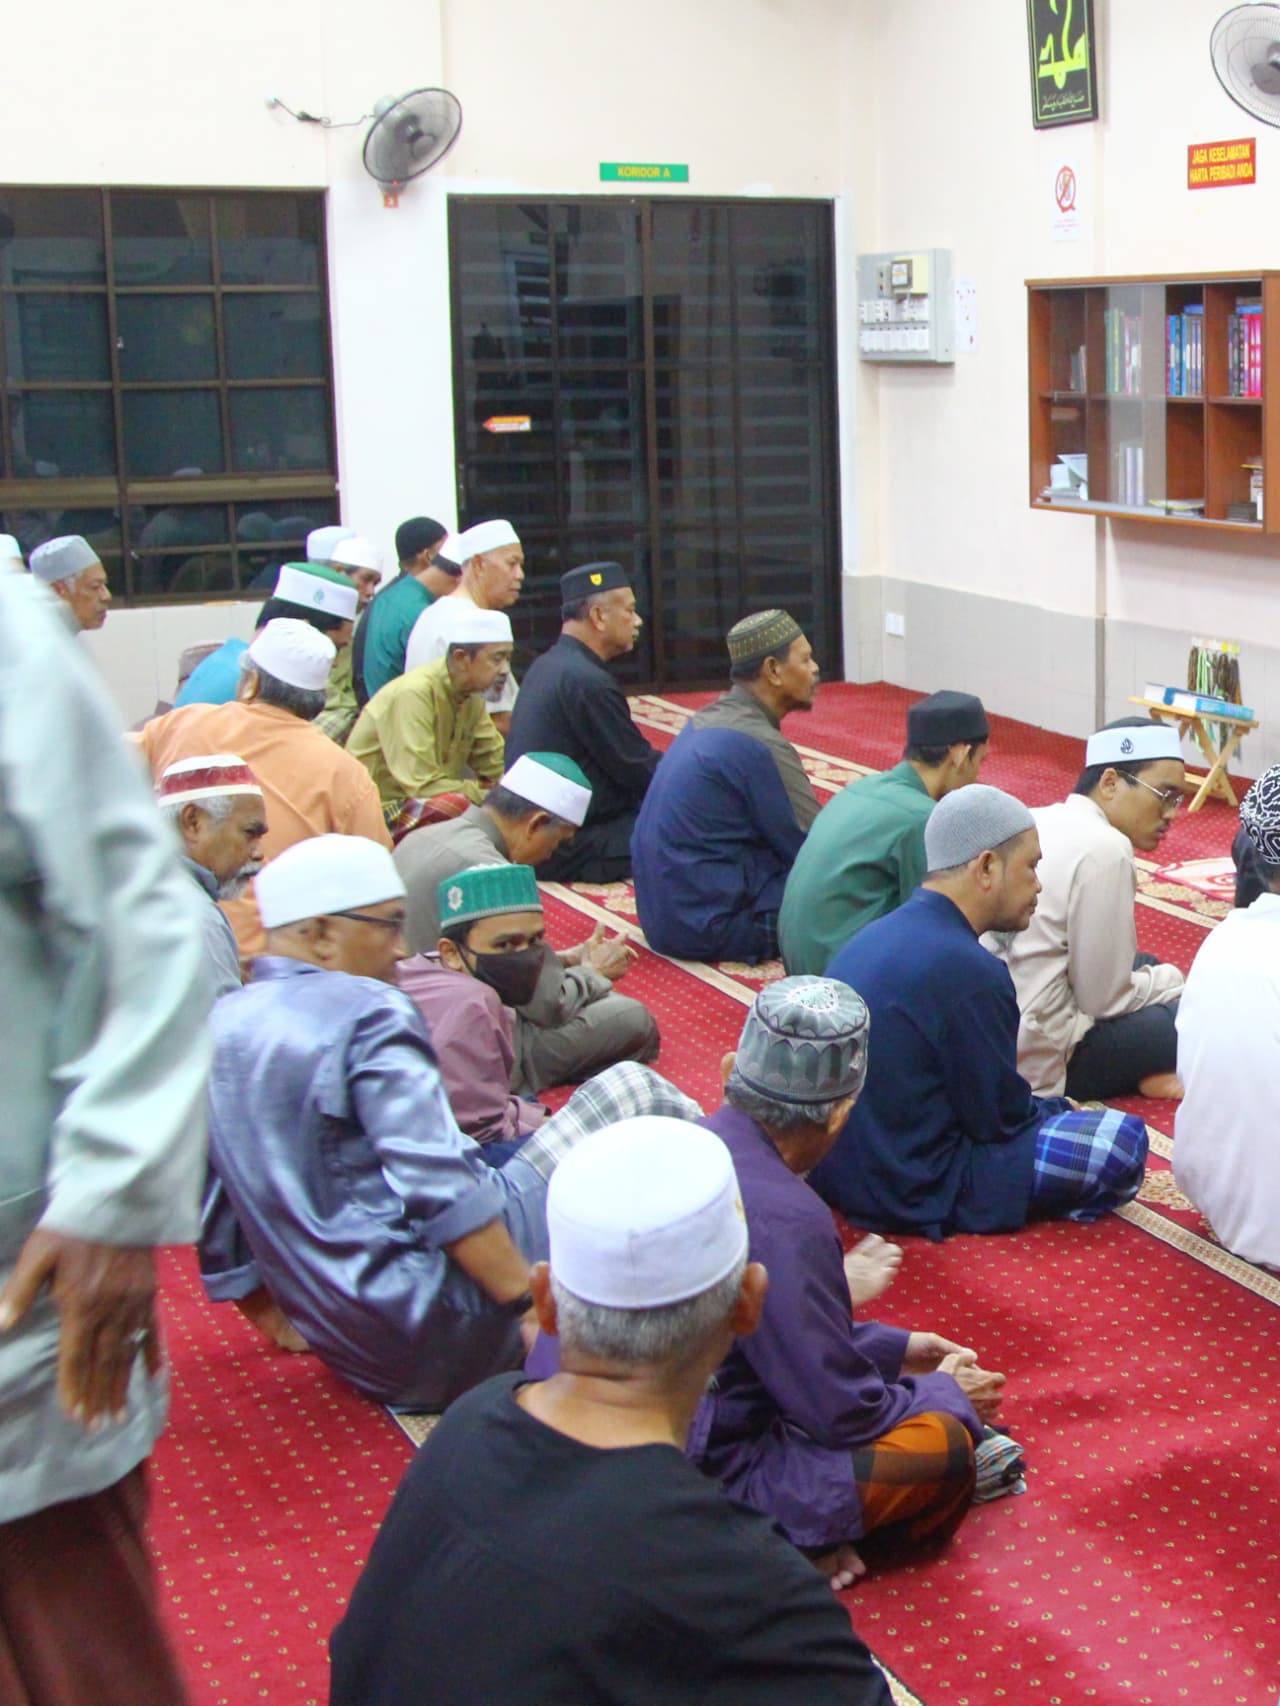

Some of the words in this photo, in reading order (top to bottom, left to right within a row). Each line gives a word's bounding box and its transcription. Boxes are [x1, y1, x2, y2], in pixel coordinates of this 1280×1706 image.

[1191, 148, 1208, 165] JAGA
[1208, 143, 1251, 163] KESELAMATAN
[663, 167, 671, 178] A
[1189, 167, 1208, 185] HARTA
[1208, 164, 1237, 182] PERIBADI
[1236, 161, 1254, 178] ANDA
